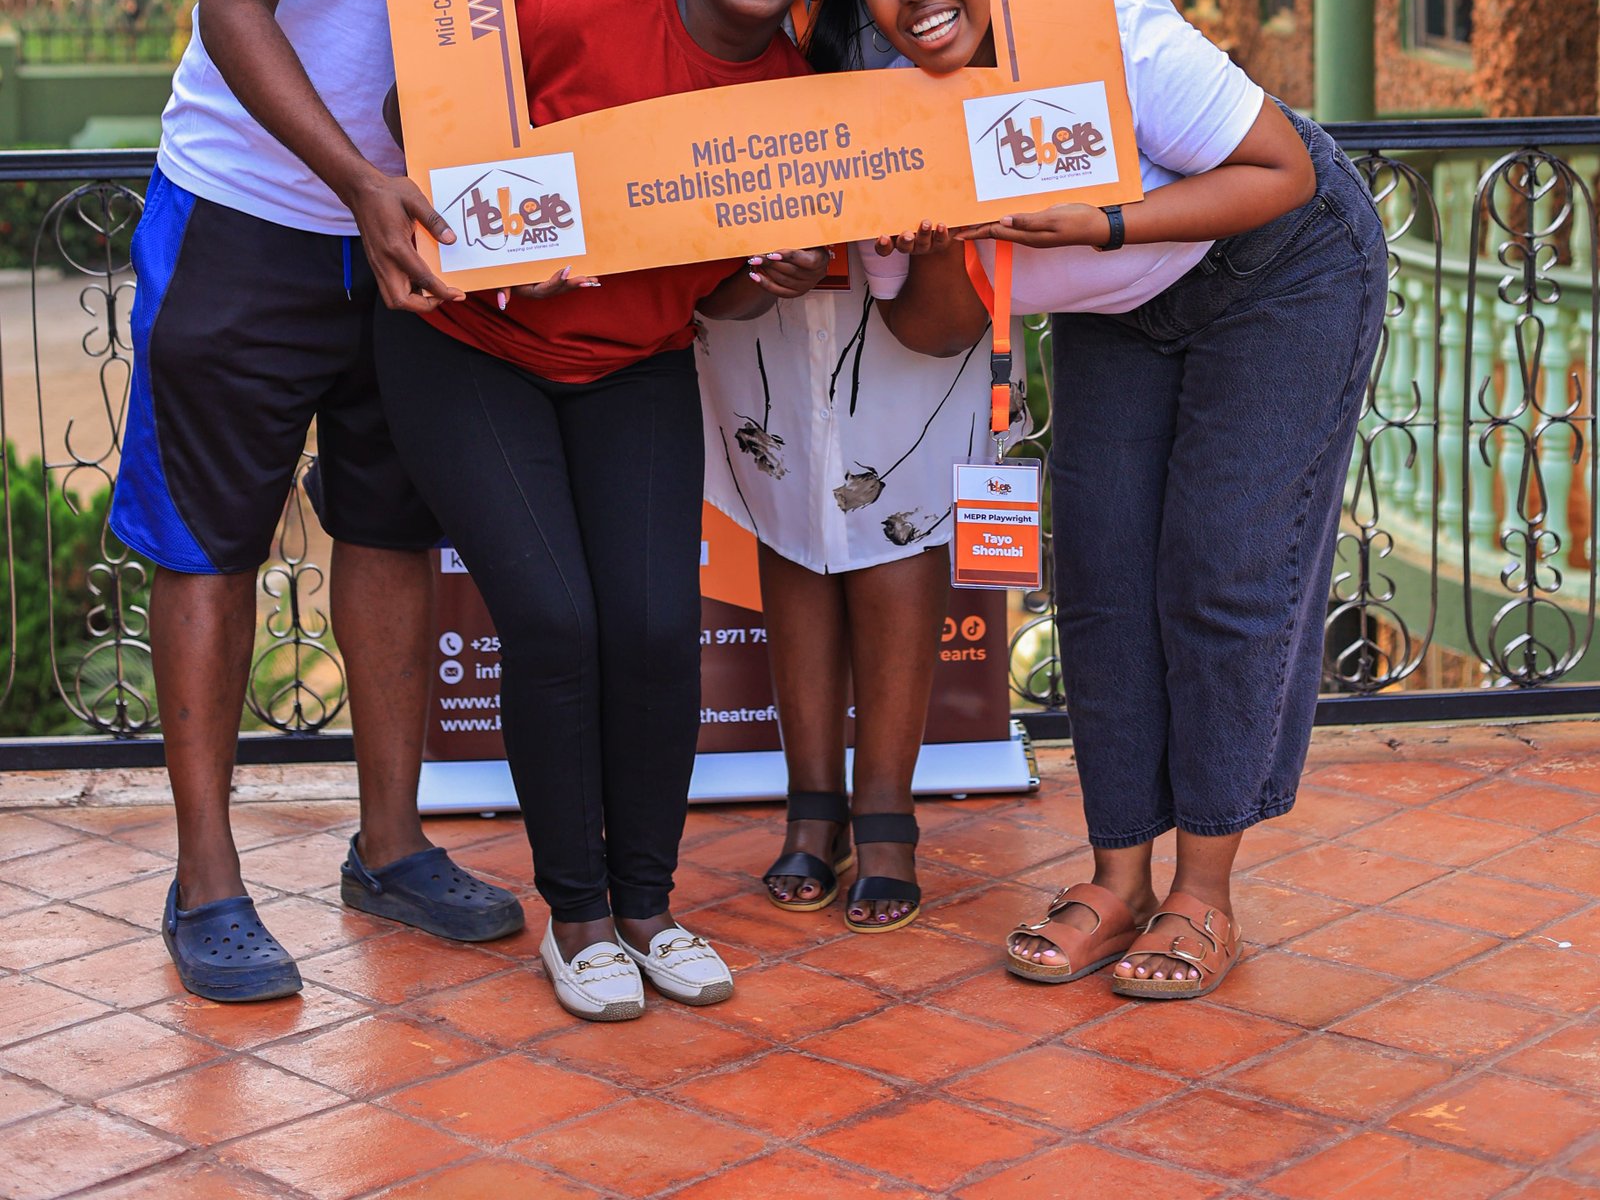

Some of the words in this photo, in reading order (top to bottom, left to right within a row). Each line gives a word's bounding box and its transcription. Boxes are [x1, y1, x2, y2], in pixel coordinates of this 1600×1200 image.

[691, 129, 829, 167] Mid-Career
[834, 122, 852, 148] &
[1000, 116, 1107, 167] tebere
[1054, 154, 1092, 174] ARTS
[626, 164, 772, 208] Established
[778, 146, 925, 188] Playwrights
[466, 187, 575, 237] tebere
[715, 190, 844, 228] Residency
[520, 226, 559, 245] ARTS
[963, 513, 987, 521] MEPR
[988, 514, 1033, 524] Playwright
[982, 532, 1013, 546] Tayo
[972, 545, 1024, 558] Shonubi
[470, 637, 501, 652] +25
[716, 629, 746, 644] 971
[940, 647, 987, 661] earts
[475, 663, 502, 679] inf
[440, 694, 501, 710] www.t
[700, 705, 778, 724] theatref
